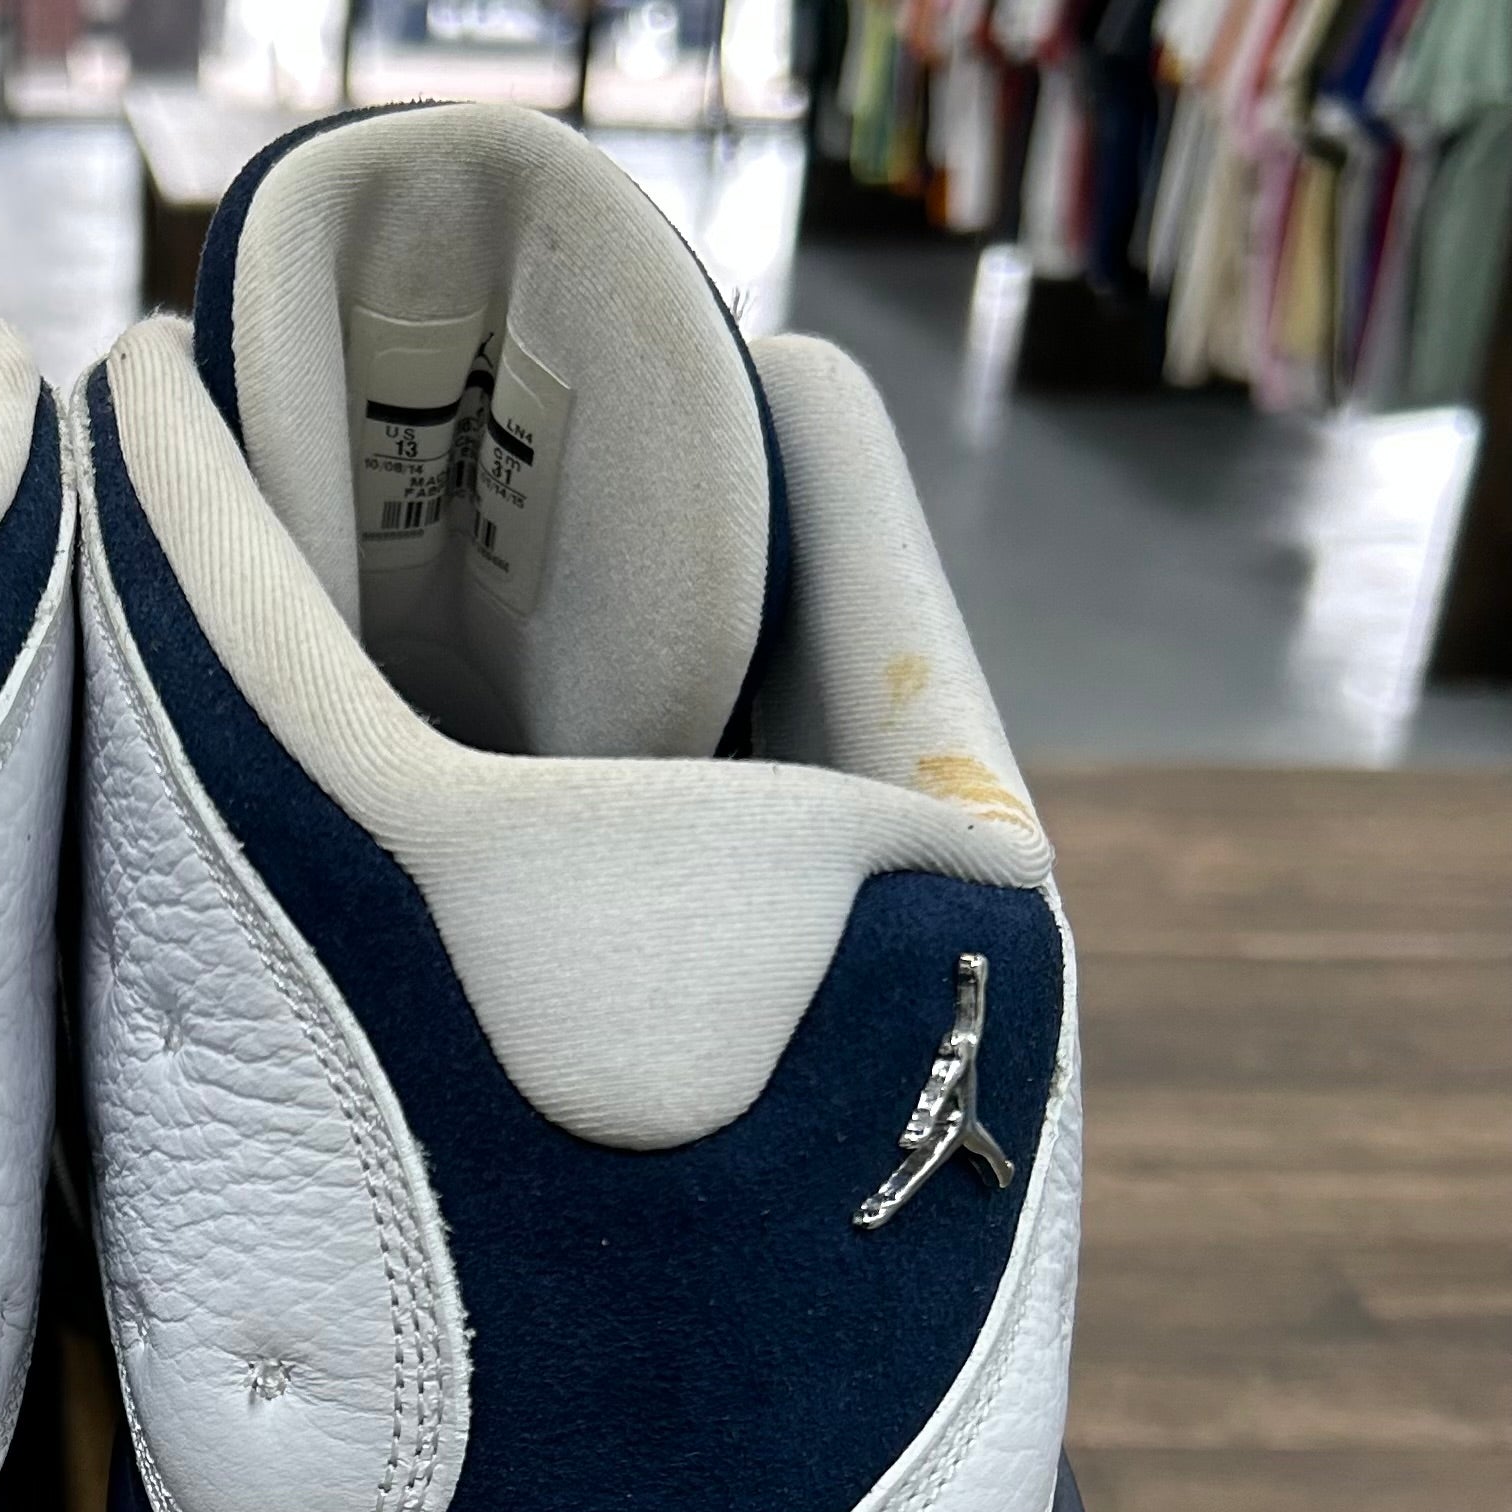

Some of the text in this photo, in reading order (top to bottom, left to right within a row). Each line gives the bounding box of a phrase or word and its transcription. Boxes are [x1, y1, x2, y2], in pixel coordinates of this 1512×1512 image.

[385, 425, 416, 441] US
[507, 418, 534, 445] LN4
[396, 439, 418, 458] 13
[493, 447, 522, 473] cm
[491, 460, 513, 486] 31
